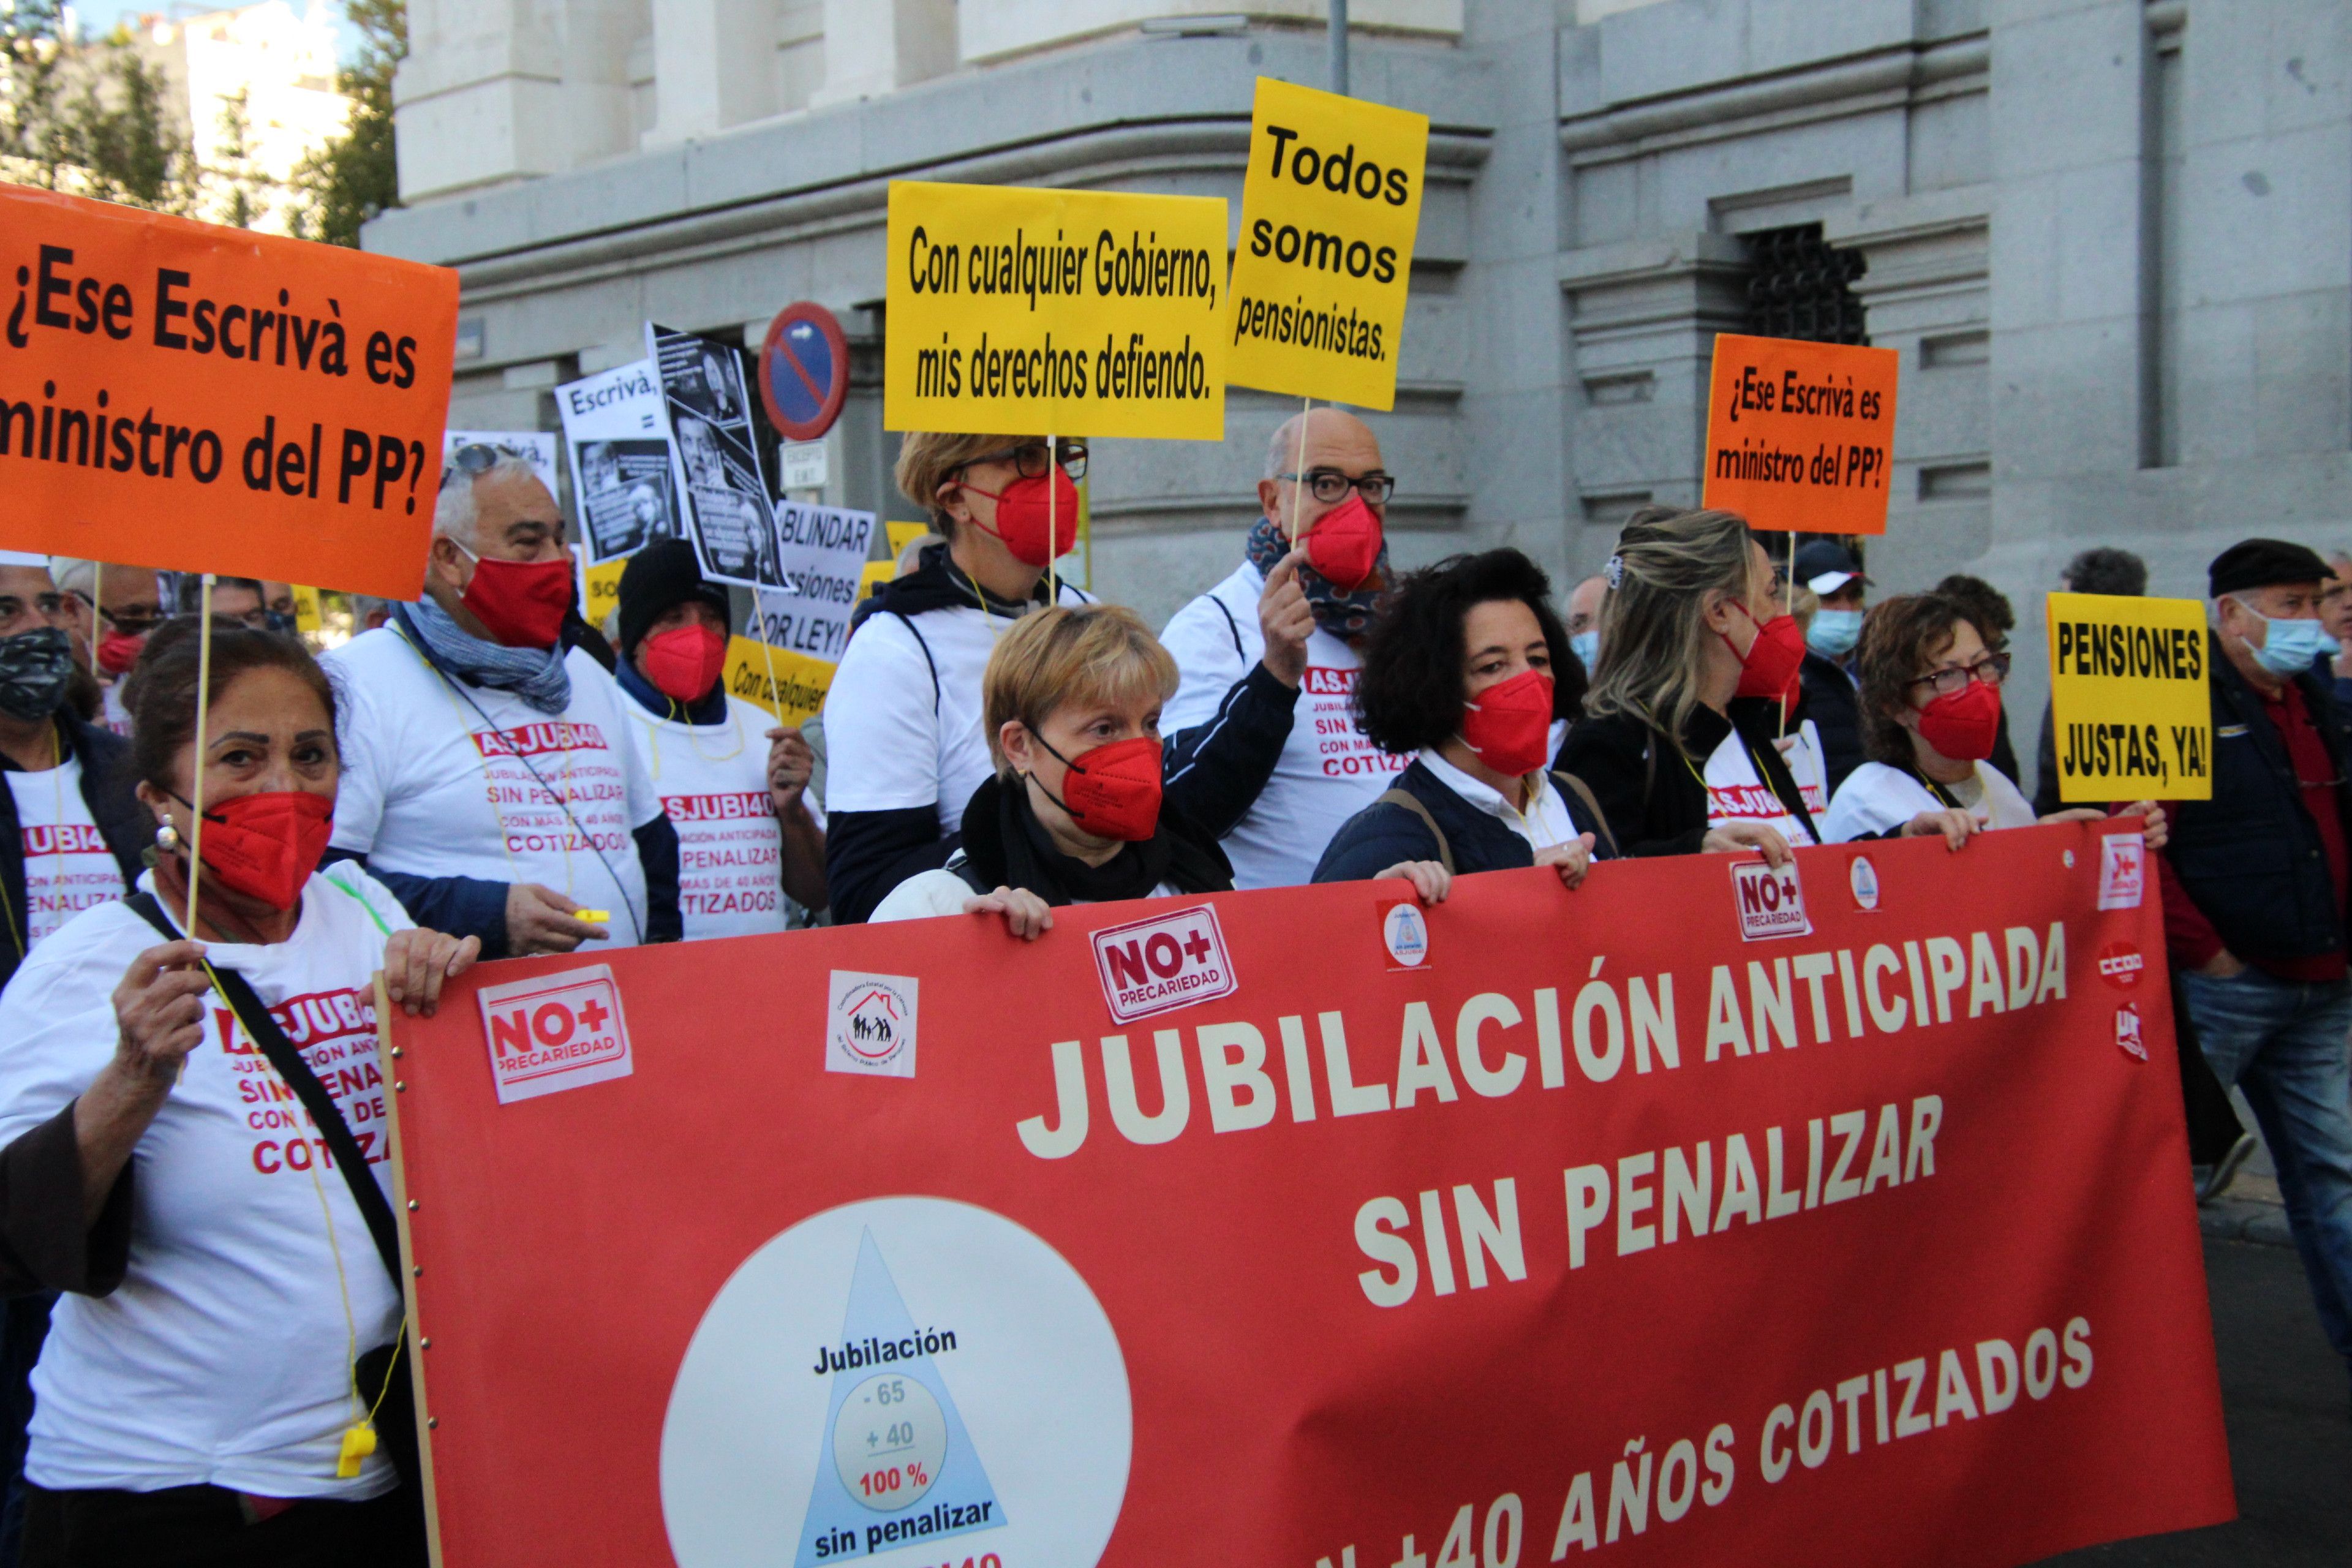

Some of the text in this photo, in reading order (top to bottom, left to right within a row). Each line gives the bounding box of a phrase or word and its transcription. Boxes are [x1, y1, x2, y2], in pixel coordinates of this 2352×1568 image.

[1266, 124, 1409, 206] Todos
[909, 225, 1216, 312] Con cualquier Gobierno,
[1250, 218, 1396, 284] somos
[6, 244, 417, 389] ¿Ese Escrivà es
[1234, 295, 1386, 362] pensionistas.
[915, 331, 1210, 400] mis derechos defiendo.
[569, 369, 657, 416] Escrivà,
[1730, 366, 1881, 422] ¿Ese Escrivà es
[243, 415, 322, 499] del
[337, 428, 426, 516] PP?
[1716, 437, 1883, 489] ministro del PP?
[780, 509, 869, 552] BLINDAR
[794, 616, 845, 655] LEY!
[2058, 622, 2201, 680] PENSIONES
[733, 660, 759, 697] Con
[1314, 717, 1348, 735] SIN
[1319, 740, 1349, 754] CON
[2063, 723, 2206, 788] JUSTAS, YA!
[486, 784, 625, 805] SIN PENALIZAR
[666, 794, 775, 821] SJUBI40
[500, 815, 531, 827] CON
[682, 848, 778, 869] PENALIZAR
[683, 891, 777, 916] TIZADOS
[714, 876, 729, 888] DE
[1740, 873, 1797, 914] NO+
[1746, 911, 1802, 927] PRECARIEDAD
[1104, 929, 1212, 992] NO+
[1118, 969, 1220, 1007] PRECARIEDAD
[491, 998, 609, 1058] NO+
[1016, 922, 2068, 1159] JUBILACIÓN ANTICIPADA
[238, 1079, 295, 1104] SIN
[248, 1110, 297, 1131] CON
[353, 1096, 387, 1123] DE
[1353, 1094, 1943, 1308] SIN PENALIZAR
[813, 1325, 957, 1375] Jubilación
[877, 1379, 905, 1406] 65
[886, 1420, 914, 1446] 40
[1550, 1423, 1735, 1563] AÑOS
[1760, 1316, 2094, 1484] COTIZADOS
[859, 1461, 928, 1497] 100 %
[815, 1500, 993, 1559] sin penalizar
